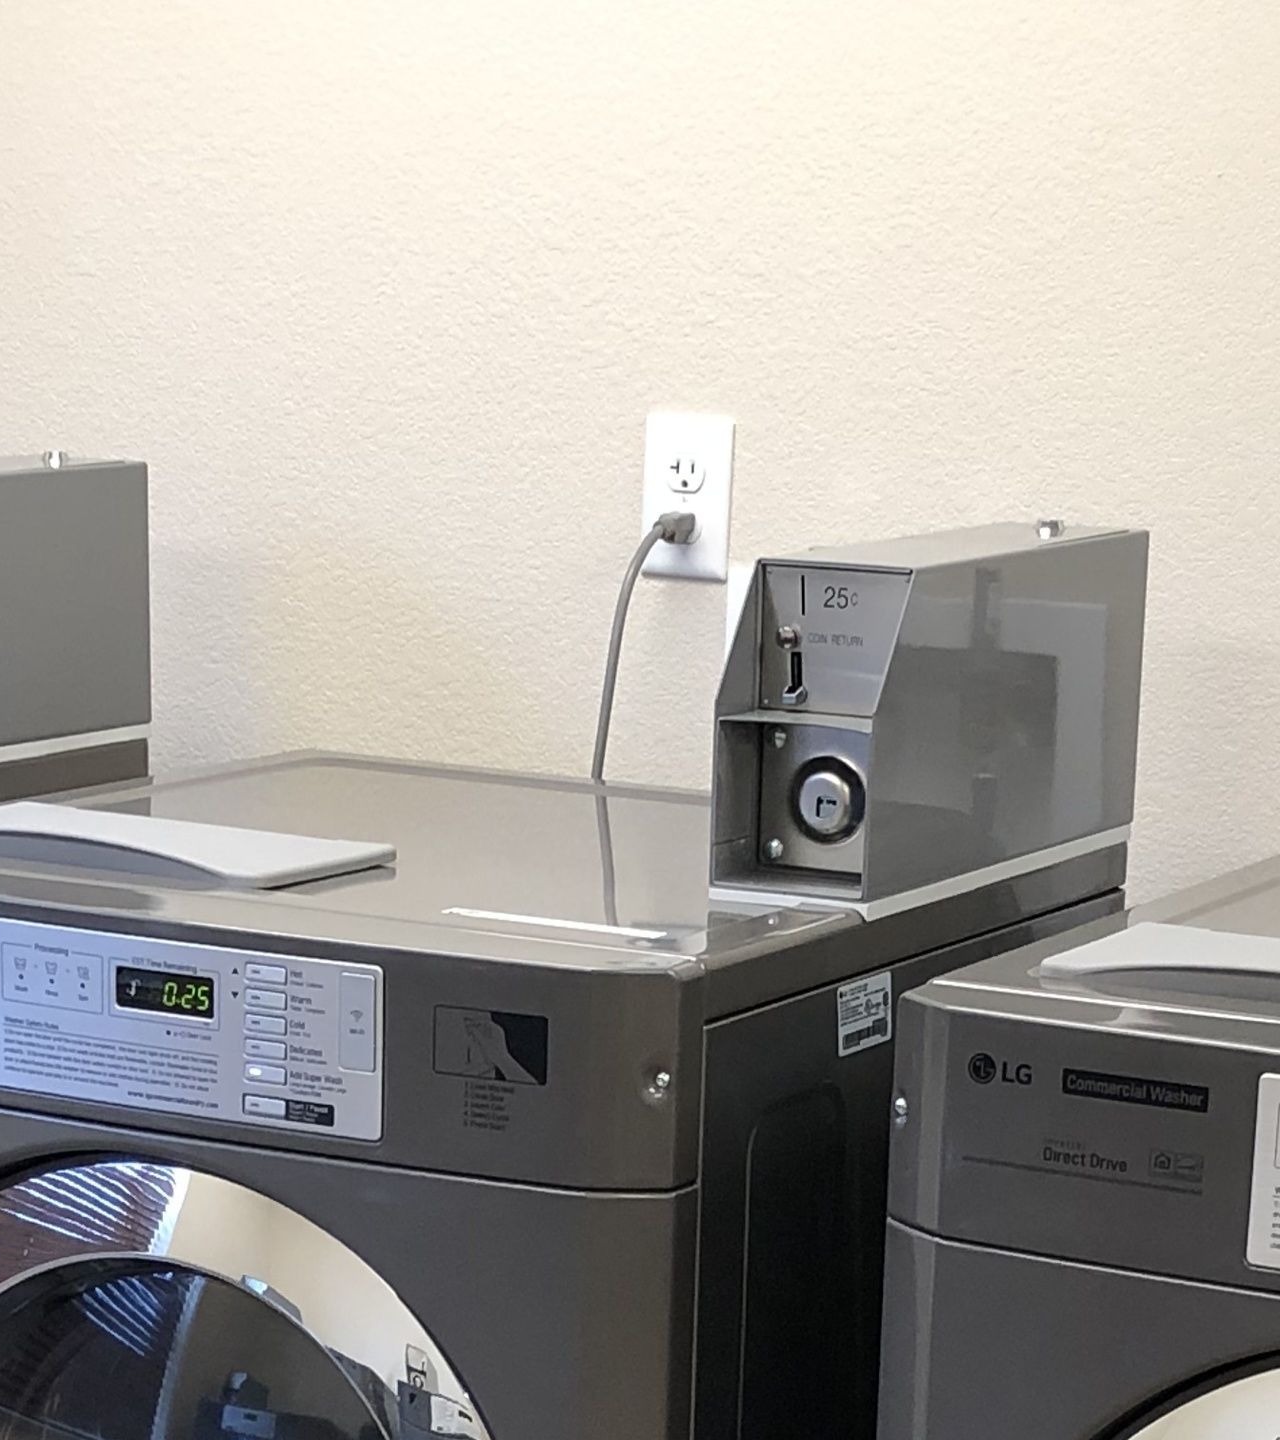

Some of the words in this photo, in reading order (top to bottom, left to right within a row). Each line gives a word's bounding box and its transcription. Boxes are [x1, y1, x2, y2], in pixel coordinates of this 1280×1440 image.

[808, 632, 828, 645] COIN
[831, 633, 864, 647] RETURN
[1001, 1061, 1032, 1085] LG
[1066, 1073, 1147, 1100] Commercial
[1150, 1085, 1205, 1108] Washer
[1043, 1146, 1086, 1168] Direct
[1090, 1152, 1128, 1173] Drive
